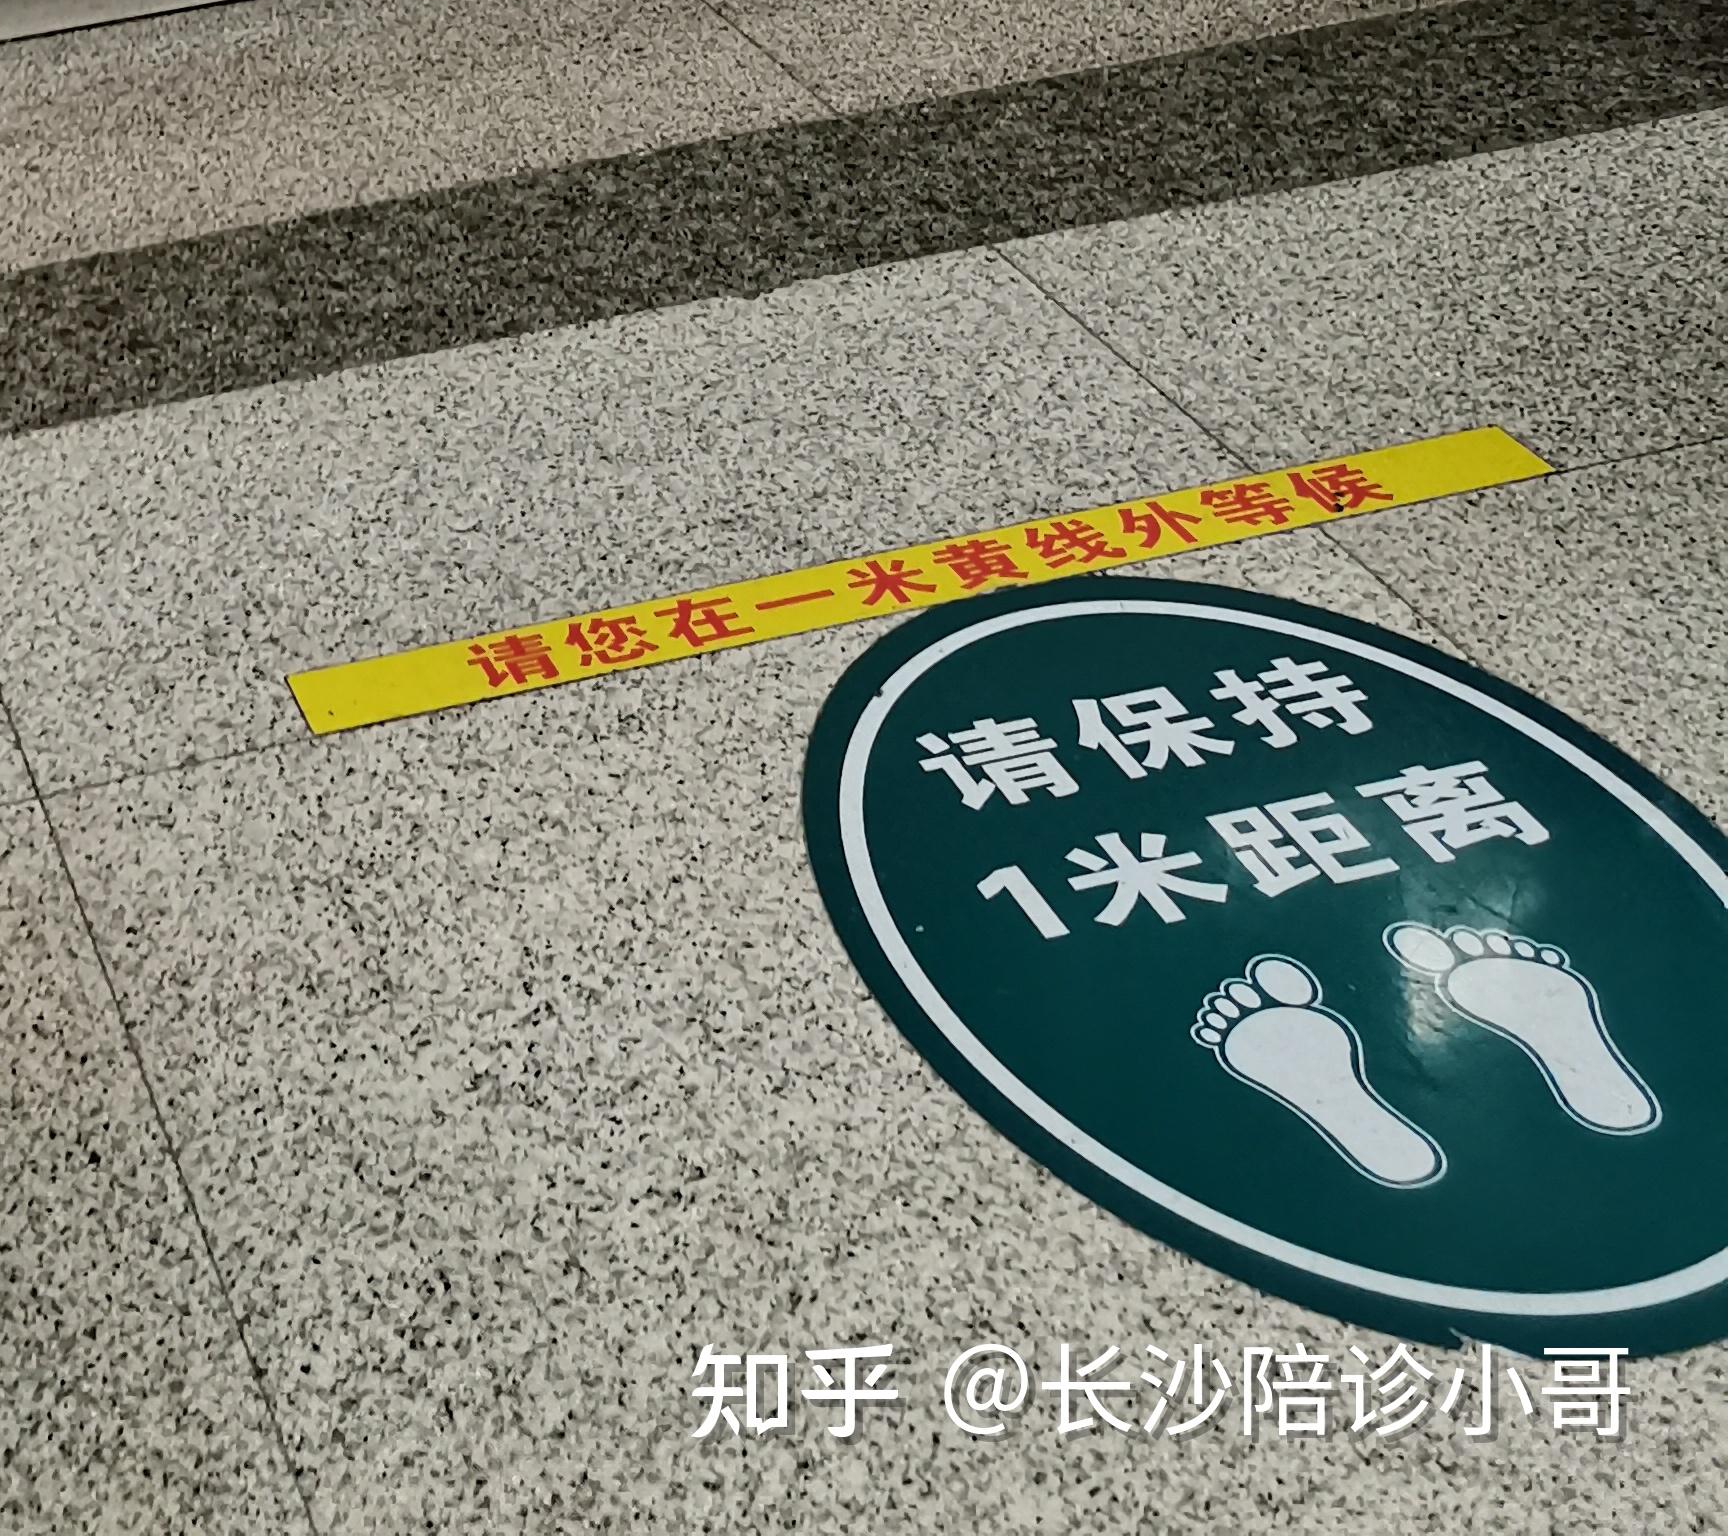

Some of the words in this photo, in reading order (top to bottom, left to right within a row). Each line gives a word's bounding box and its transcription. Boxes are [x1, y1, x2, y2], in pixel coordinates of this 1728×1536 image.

[468, 462, 1396, 690] 请您在一米黄线外等候
[916, 655, 1373, 813] 请保持
[976, 760, 1550, 939] 1米距离
